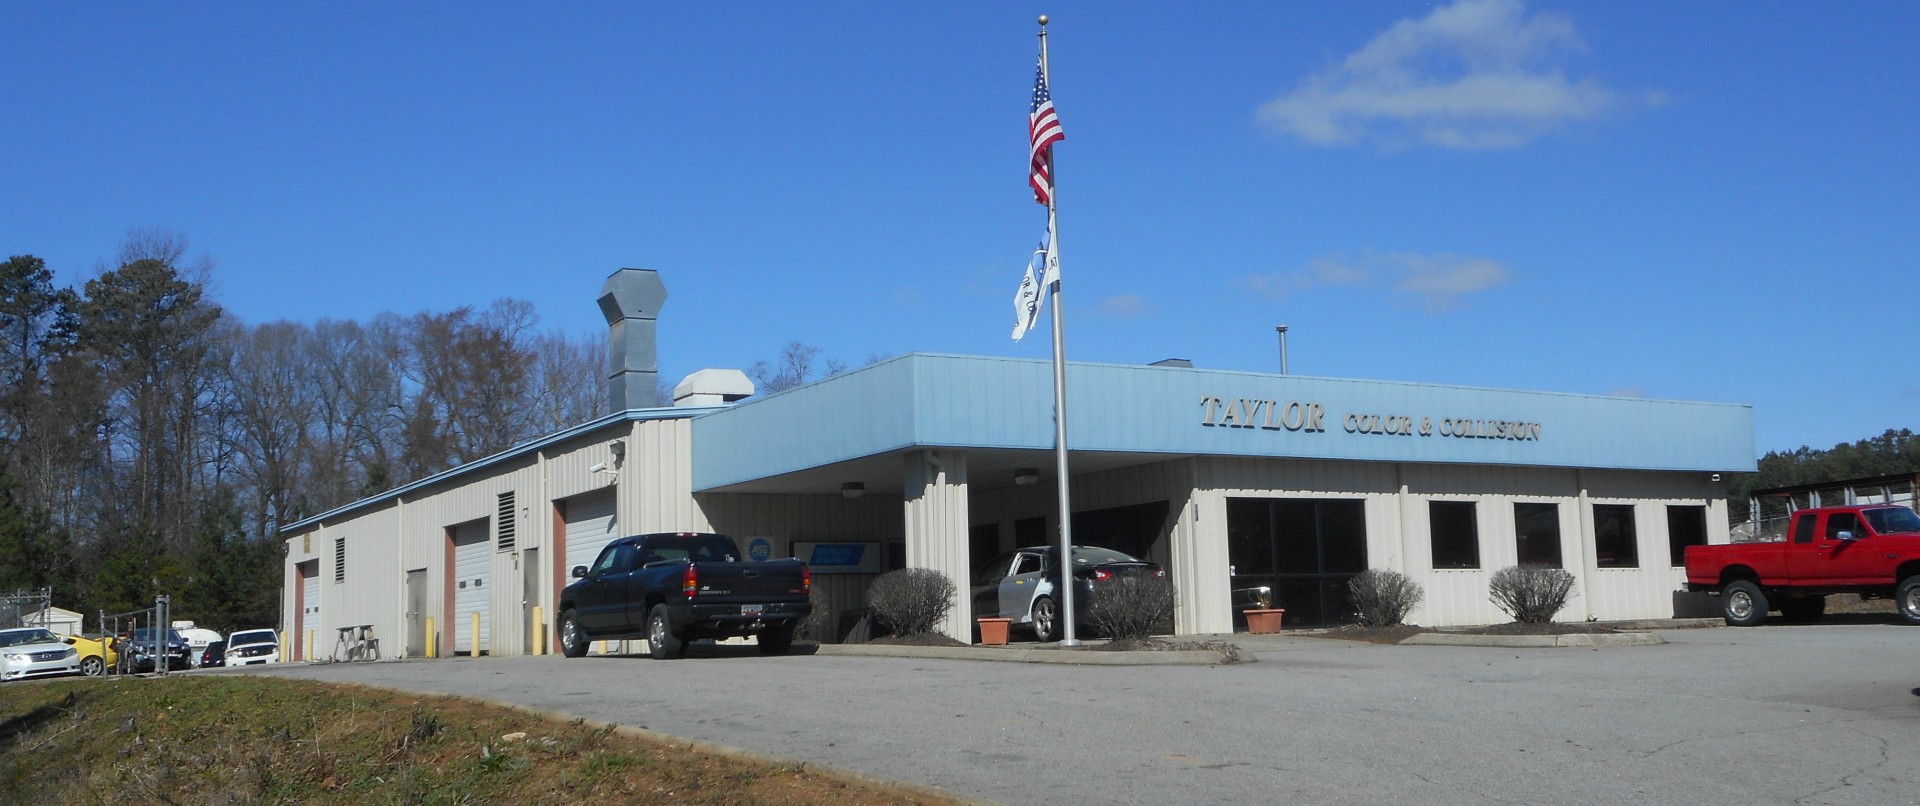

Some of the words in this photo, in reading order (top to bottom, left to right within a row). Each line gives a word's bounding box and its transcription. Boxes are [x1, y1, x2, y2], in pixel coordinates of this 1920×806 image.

[1200, 395, 1325, 433] TAYLOR
[1343, 413, 1412, 437] COLOR
[1418, 416, 1432, 437] &
[1439, 418, 1541, 441] COLLISION
